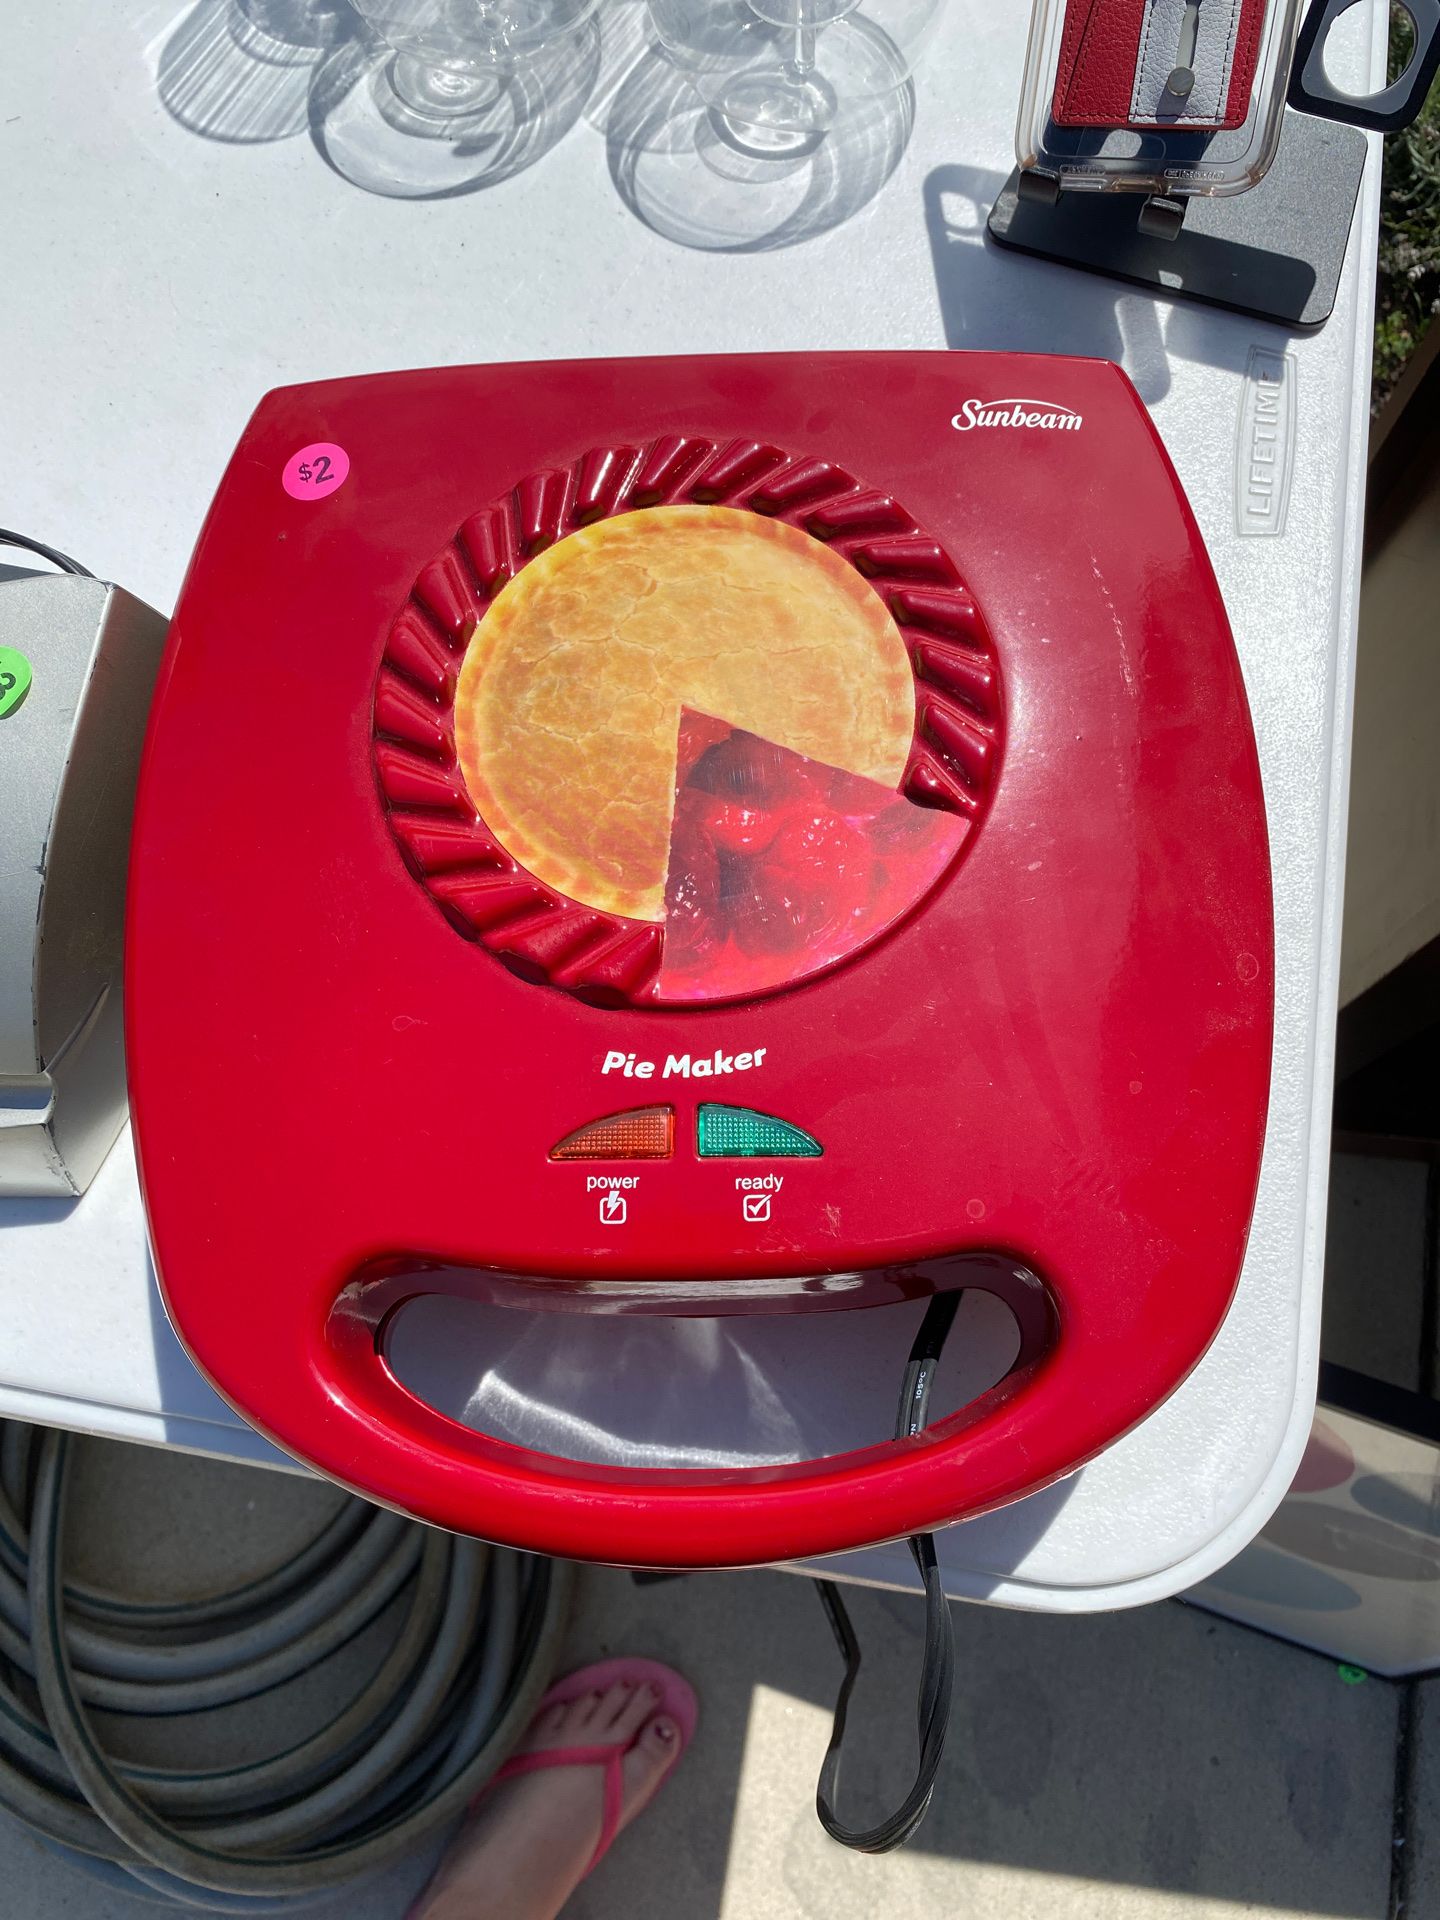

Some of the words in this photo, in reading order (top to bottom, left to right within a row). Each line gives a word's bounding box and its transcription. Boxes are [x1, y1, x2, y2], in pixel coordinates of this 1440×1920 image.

[951, 399, 1083, 431] Sunbeam
[299, 456, 334, 484] $2
[0, 661, 16, 700] 3
[601, 1050, 654, 1079] Pie
[661, 1047, 767, 1079] Maker
[586, 1175, 640, 1192] power
[735, 1173, 784, 1192] ready
